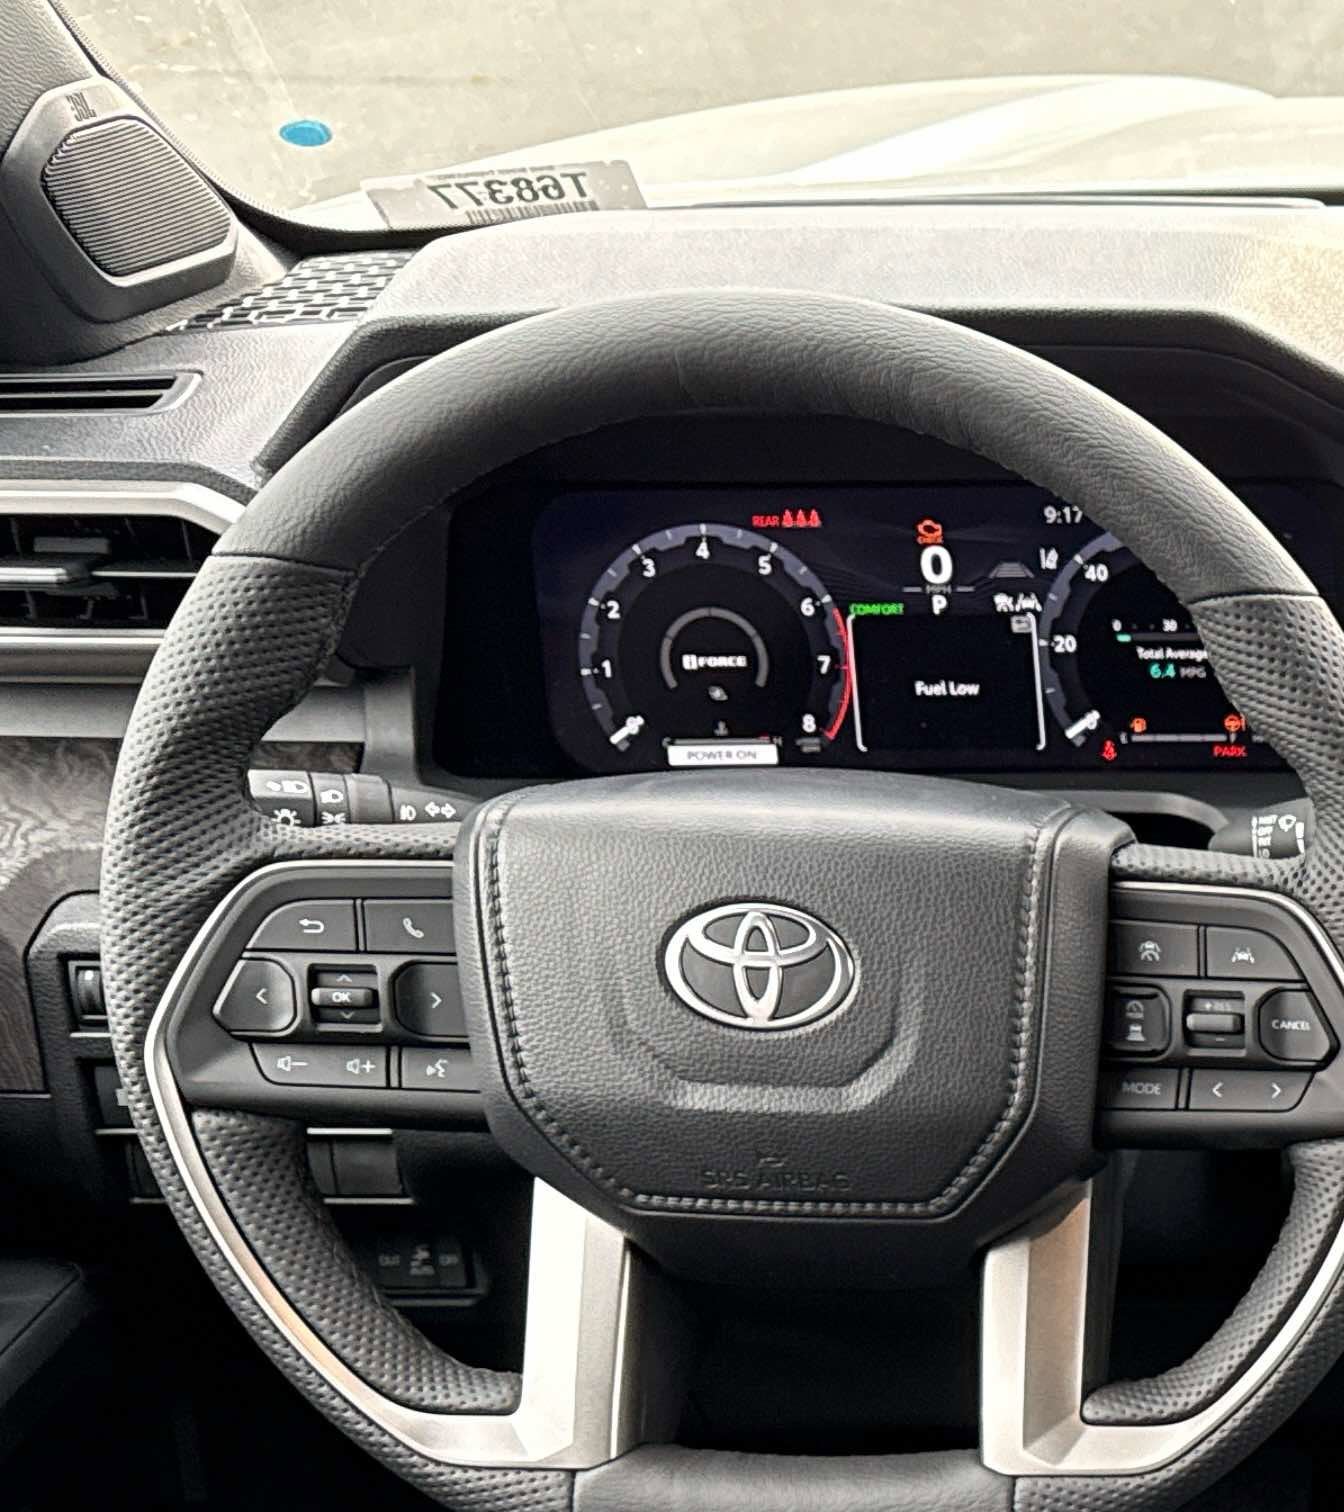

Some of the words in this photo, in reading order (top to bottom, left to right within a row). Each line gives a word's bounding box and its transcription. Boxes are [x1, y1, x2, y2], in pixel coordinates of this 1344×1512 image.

[1043, 505, 1083, 524] 9:17
[696, 541, 710, 559] 4
[642, 557, 656, 578] 3
[758, 555, 772, 576] 5
[920, 545, 953, 585] 0
[1083, 563, 1109, 582] 40
[606, 600, 621, 620] 2
[800, 597, 815, 617] 6
[932, 596, 948, 615] P
[1053, 635, 1077, 652] 20
[601, 658, 612, 679] 1
[817, 655, 832, 675] 7
[914, 681, 948, 696] Fuel
[950, 681, 980, 697] Low
[802, 713, 817, 733] 8
[741, 750, 757, 761] ON
[331, 991, 351, 1004] OK
[1271, 1019, 1310, 1031] CANCEL
[1122, 1082, 1162, 1096] MODE
